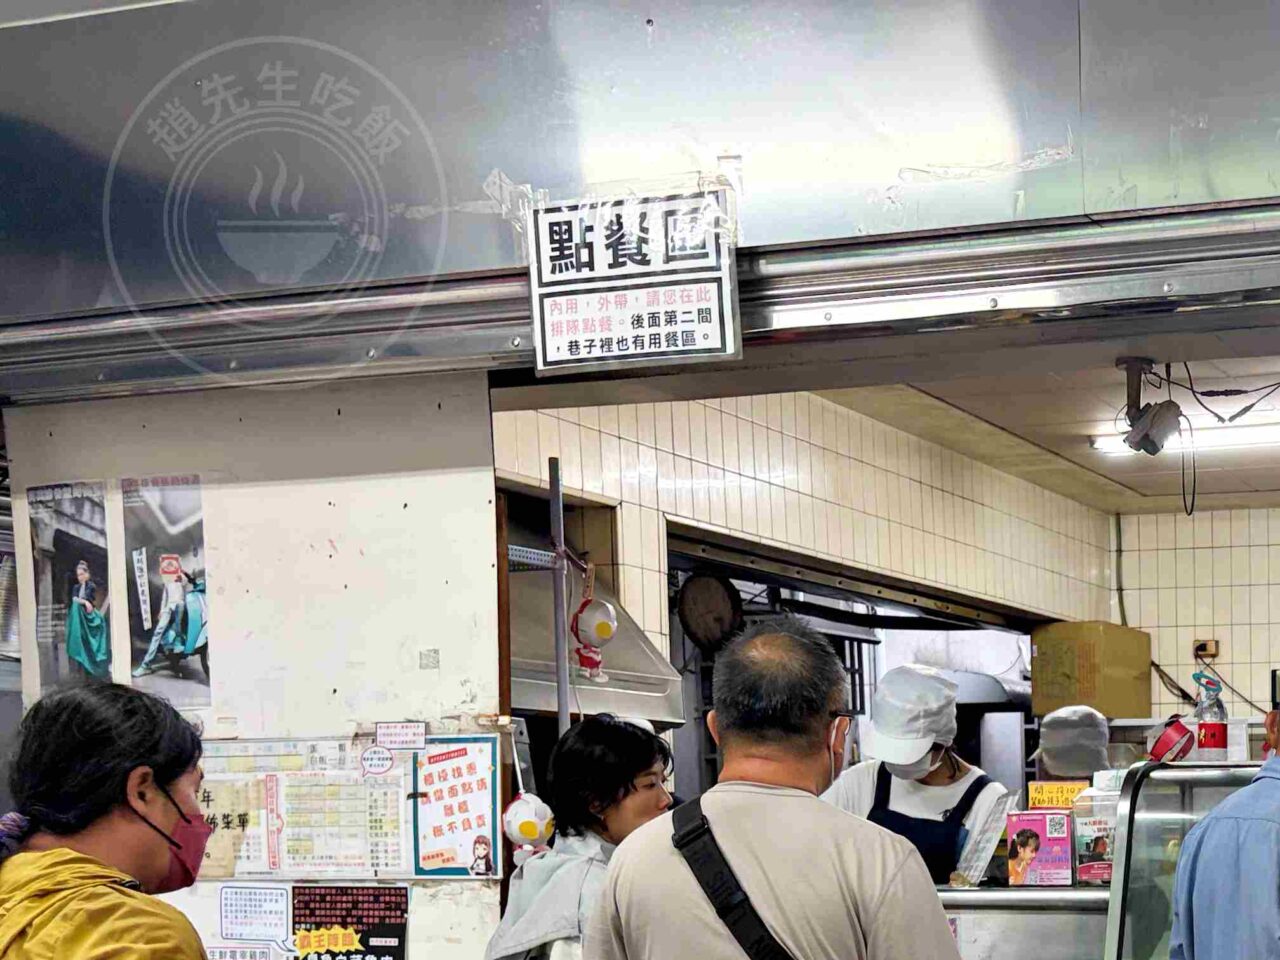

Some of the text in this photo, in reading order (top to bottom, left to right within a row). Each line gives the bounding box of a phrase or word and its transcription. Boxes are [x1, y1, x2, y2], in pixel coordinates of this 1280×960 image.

[548, 206, 709, 275] 點餐區
[550, 307, 713, 338] 排隊點餐。後面第二間
